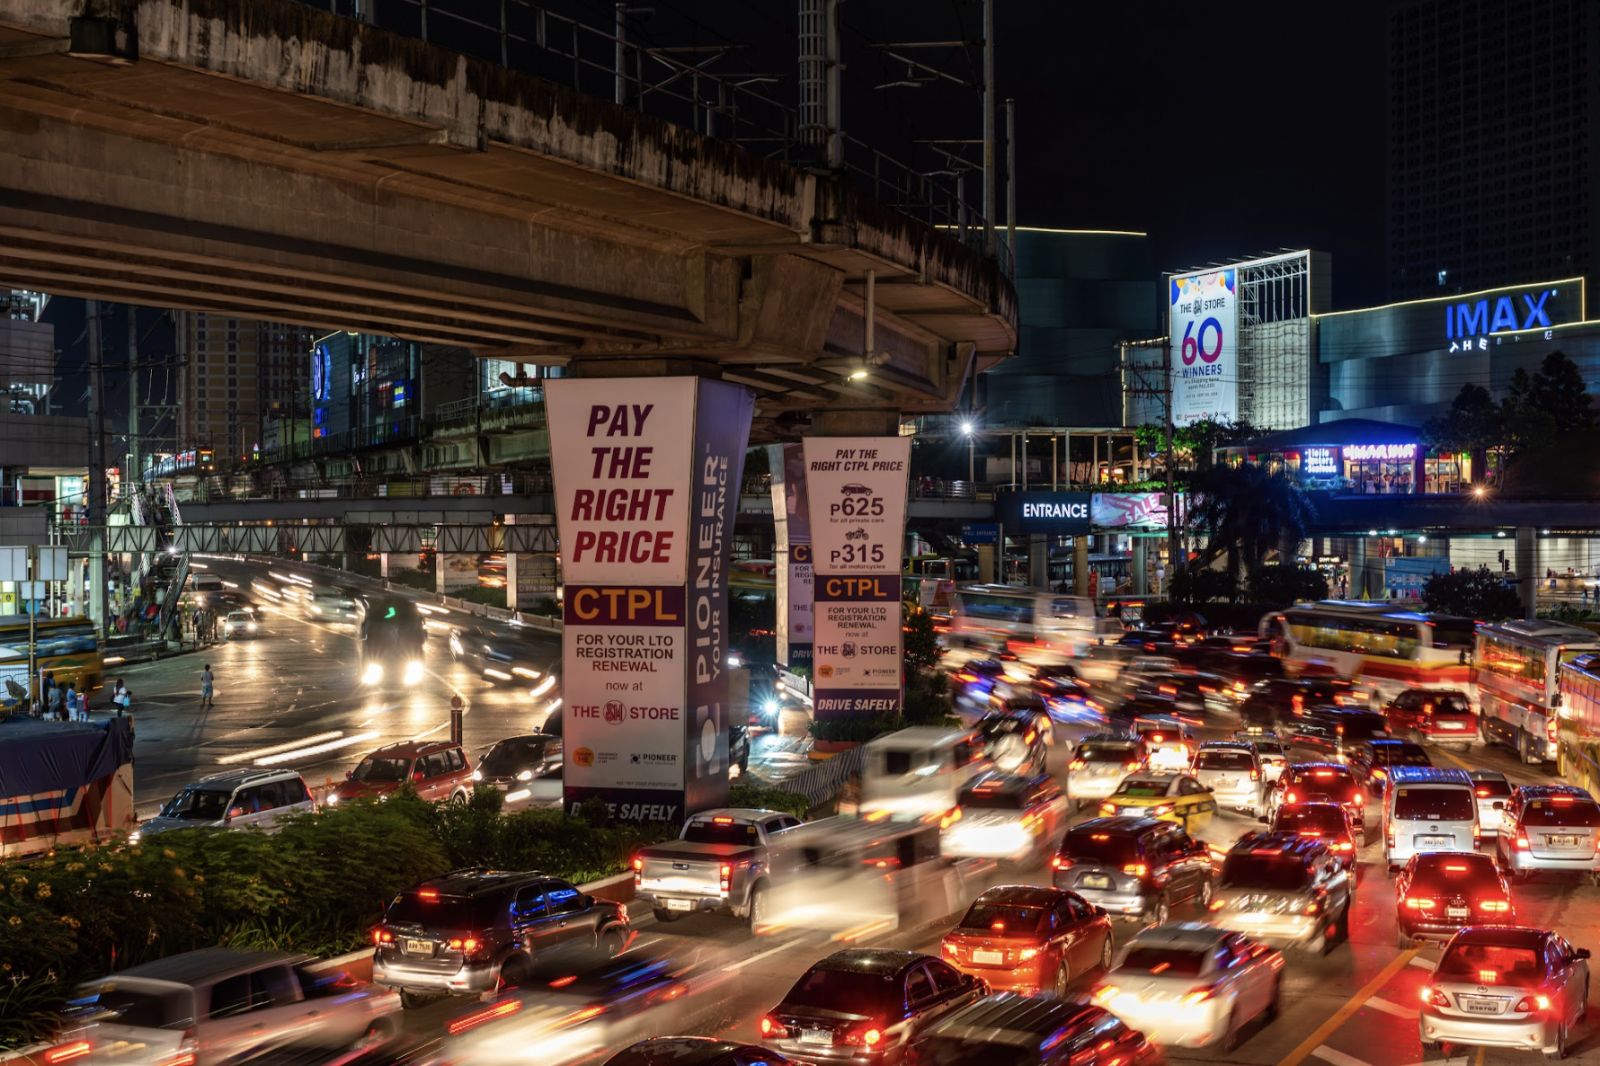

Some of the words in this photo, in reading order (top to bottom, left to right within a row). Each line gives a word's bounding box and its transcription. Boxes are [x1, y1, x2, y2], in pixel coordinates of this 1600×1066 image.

[1180, 302, 1192, 314] THE
[1204, 297, 1226, 311] STORE
[1446, 290, 1552, 339] IMAX
[1181, 316, 1223, 366] 60
[1182, 363, 1223, 379] WINNERS
[587, 404, 654, 437] PAY
[592, 447, 654, 479] THE
[835, 449, 856, 460] PAY
[858, 449, 878, 460] THE
[810, 461, 842, 471] RIGHT
[843, 461, 870, 471] CTPL
[872, 461, 903, 471] PRICE
[571, 488, 674, 521] RIGHT
[830, 497, 884, 516] P625
[1023, 503, 1088, 518] ENTRANCE
[1125, 495, 1160, 524] SALE
[711, 455, 729, 598] INSURANCE
[572, 530, 674, 563] PRICE
[830, 544, 884, 563] P315
[696, 455, 719, 685] PIONEER
[826, 578, 888, 597] CTPL
[573, 588, 677, 621] CTPL
[576, 634, 604, 646] FOR
[607, 634, 645, 646] YOUR
[649, 635, 674, 647] LTO
[712, 609, 721, 681] YOUR
[576, 647, 674, 660] REGISTRATION
[817, 646, 839, 655] THE
[860, 646, 897, 655] STORE
[592, 660, 658, 673] RENEWAL
[605, 682, 629, 691] now
[632, 681, 643, 692] at
[572, 705, 600, 718] THE
[630, 707, 679, 720] STORE
[817, 699, 852, 710] DRIVE
[854, 699, 897, 711] SAFELY
[643, 753, 677, 761] PIONEER
[620, 803, 677, 821] SAFELY
